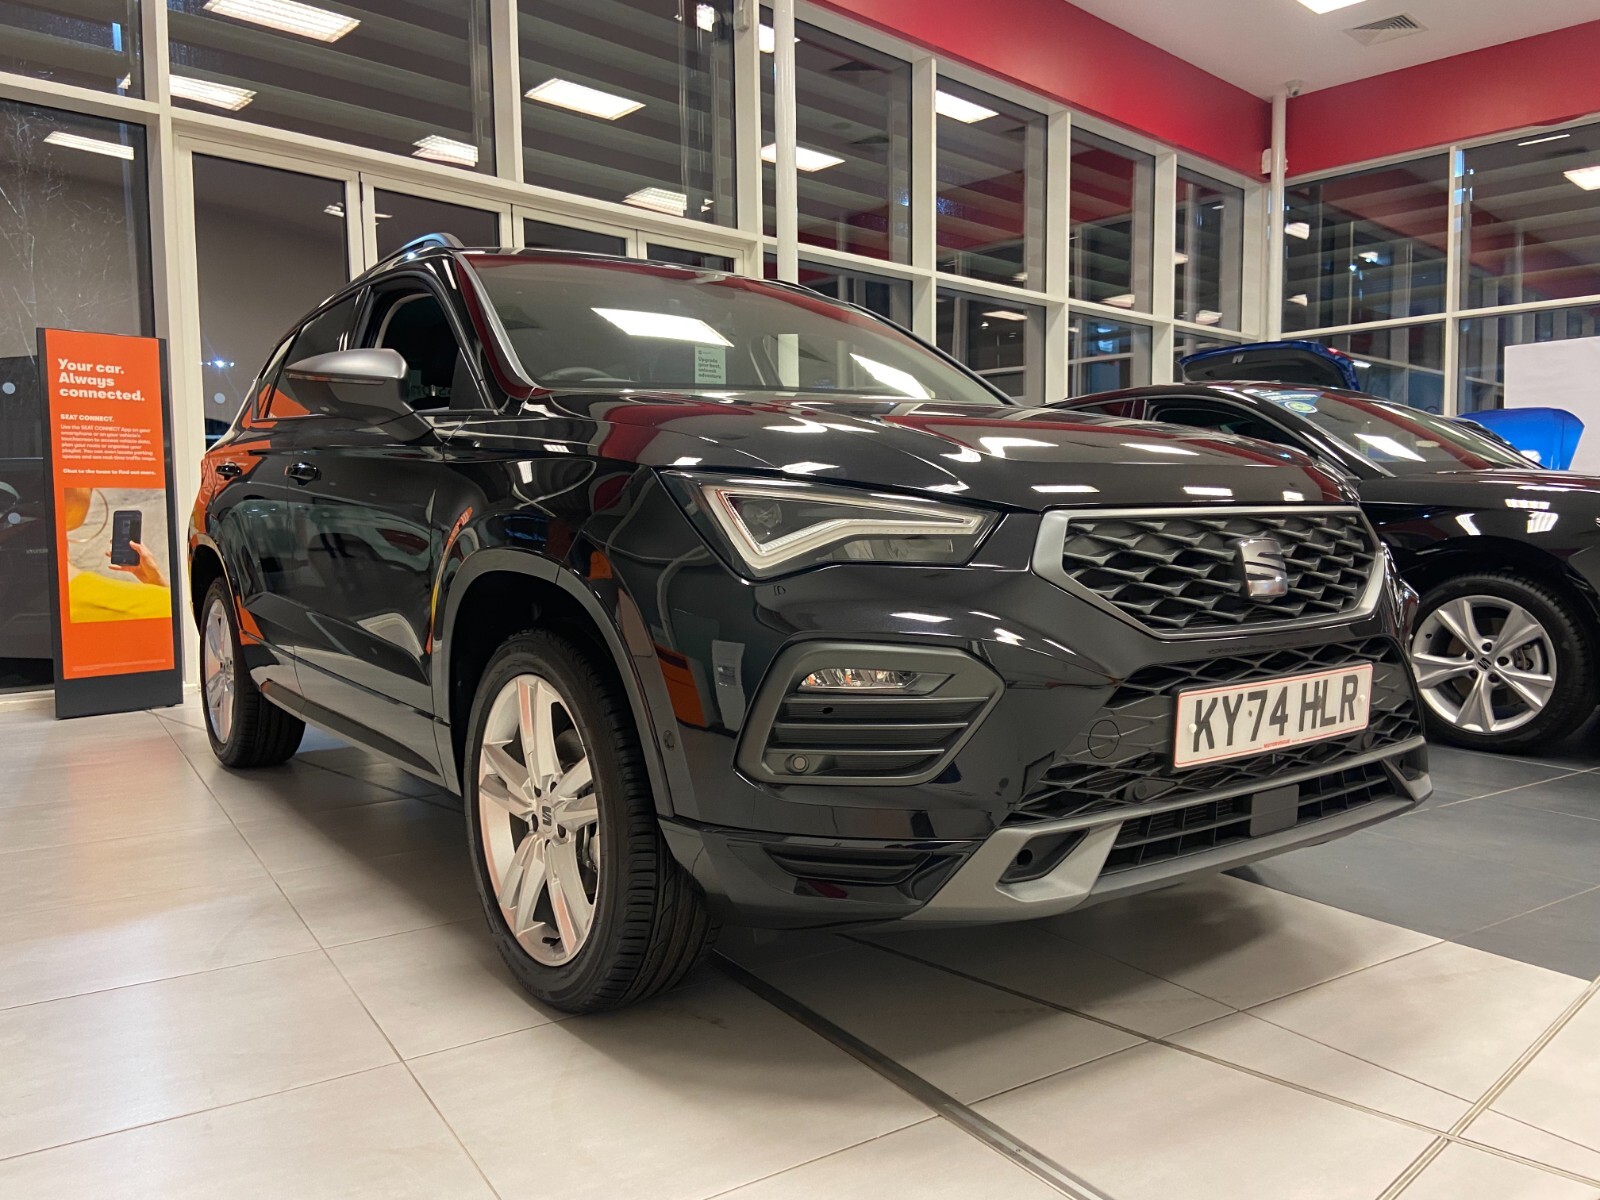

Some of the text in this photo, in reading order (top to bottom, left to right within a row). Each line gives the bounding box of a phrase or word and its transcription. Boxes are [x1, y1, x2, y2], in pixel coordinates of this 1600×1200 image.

[58, 358, 125, 374] Your car.
[58, 372, 115, 388] Always
[59, 388, 145, 401] connected.
[79, 414, 115, 422] CONNECT.
[1192, 674, 1359, 753] KY74 HLR
